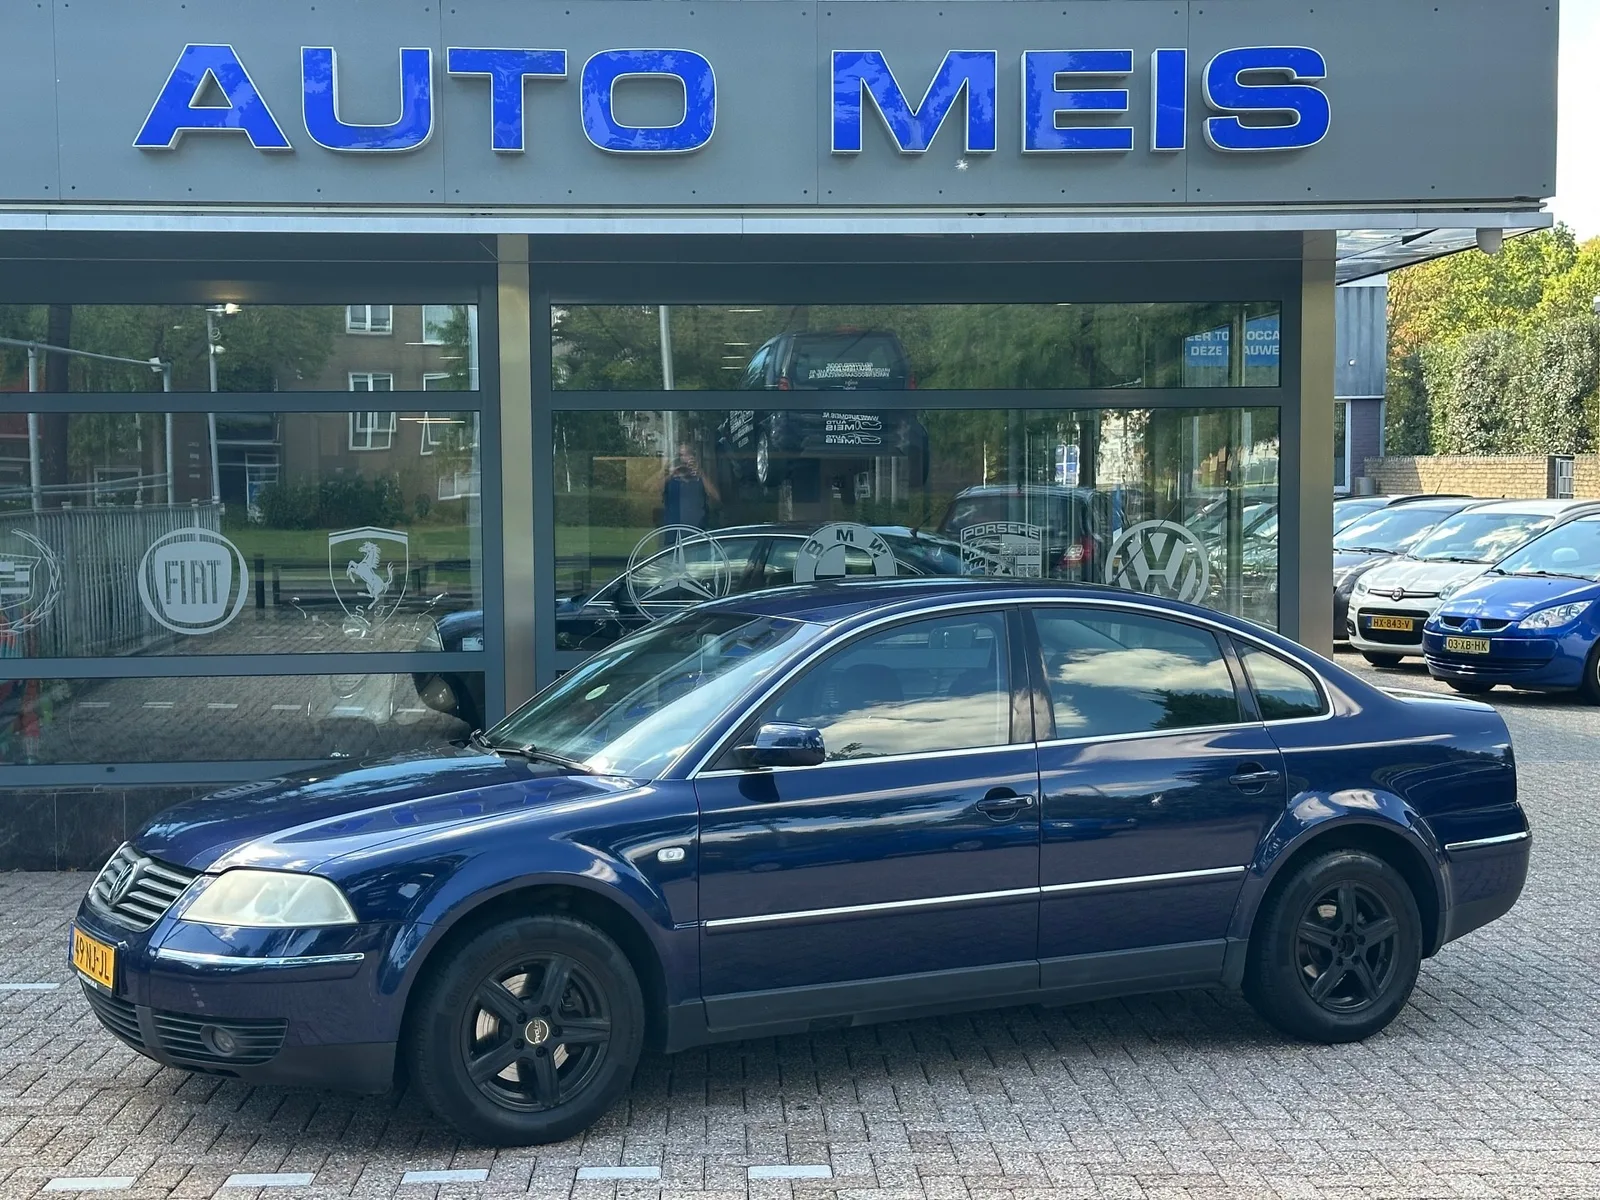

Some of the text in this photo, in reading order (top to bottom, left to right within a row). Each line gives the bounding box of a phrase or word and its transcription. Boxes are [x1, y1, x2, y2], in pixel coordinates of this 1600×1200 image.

[132, 43, 1331, 155] AUTO MEIS
[1191, 346, 1222, 356] DEZE
[963, 524, 1040, 540] PORSCHE
[164, 560, 221, 605] FIAT
[1373, 618, 1410, 629] HX-843-V
[1447, 639, 1487, 651] 03-XB-HK
